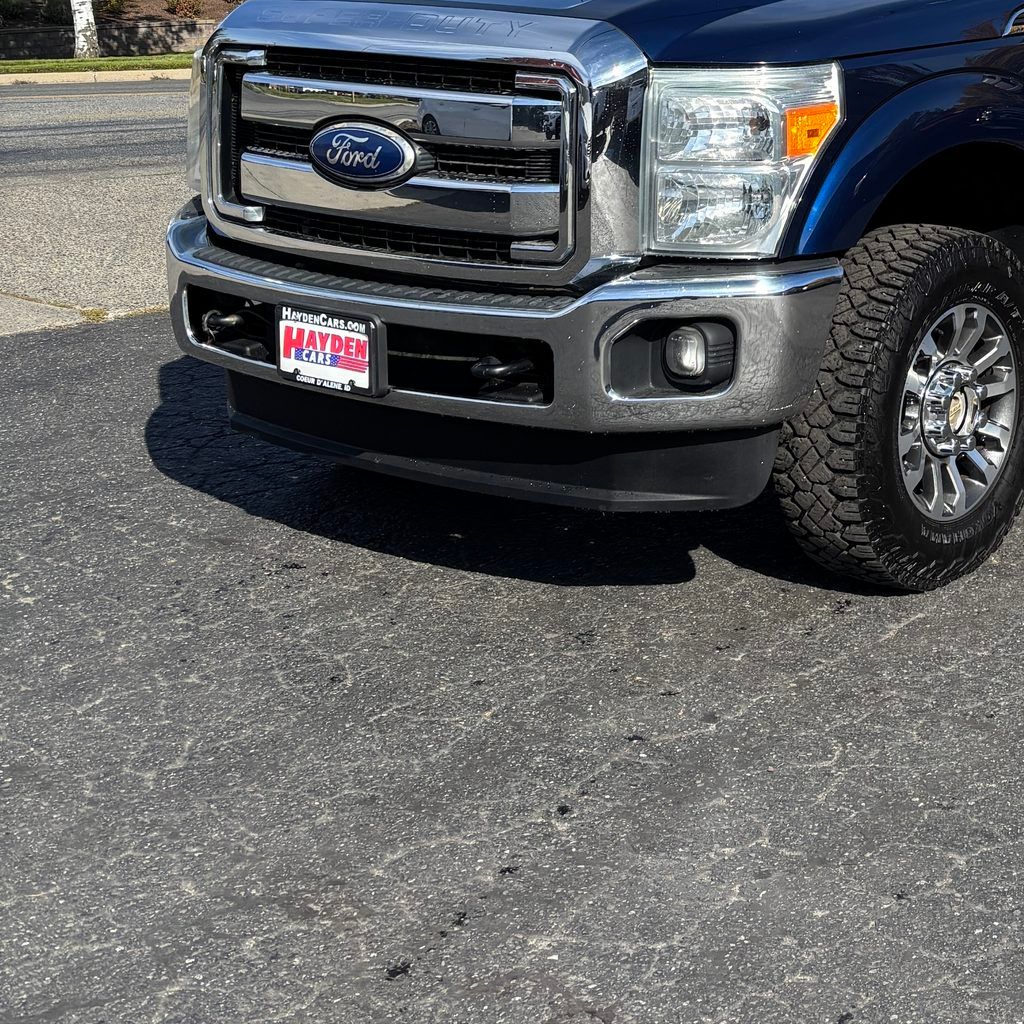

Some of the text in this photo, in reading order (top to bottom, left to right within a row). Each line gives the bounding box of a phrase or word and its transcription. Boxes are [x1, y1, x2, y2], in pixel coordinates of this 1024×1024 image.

[406, 12, 536, 37] DUTY
[326, 133, 382, 169] Ford
[283, 325, 368, 359] HAYDEN
[302, 350, 332, 366] CARS
[296, 374, 316, 385] COEUR
[344, 383, 351, 392] ID
